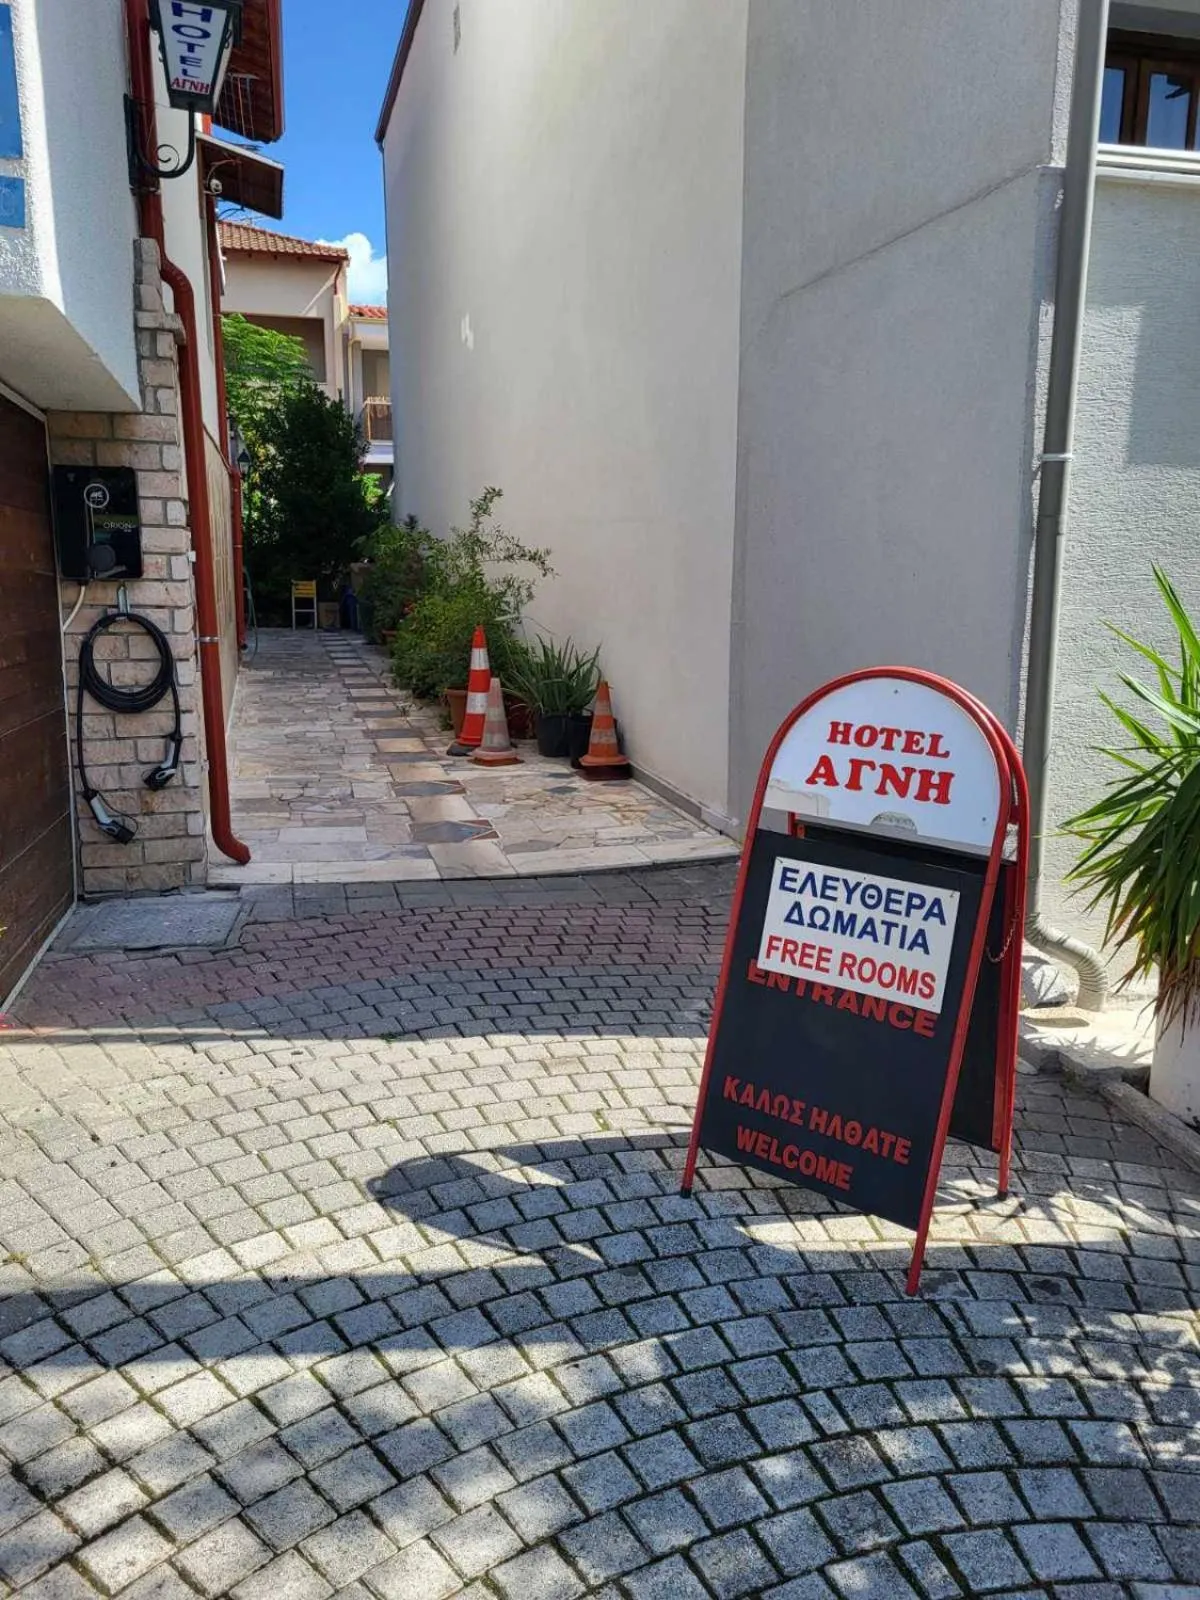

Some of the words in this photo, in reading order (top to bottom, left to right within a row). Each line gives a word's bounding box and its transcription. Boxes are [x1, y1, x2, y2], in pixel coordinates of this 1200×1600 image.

[171, 2, 213, 79] HOTEL
[827, 721, 950, 759] HOTEL
[805, 755, 955, 805] ΑΓΝΗ
[778, 866, 946, 926] ΕΛΕΥΘΕΡΑ
[783, 901, 930, 955] ΔΩΜΑΤΙΑ
[765, 935, 833, 974] FREE
[838, 951, 936, 1000] ROOMS
[723, 1075, 806, 1126] ΚΑΛΩΣ
[808, 1106, 912, 1165] ΗΛΘΑΤΕ
[736, 1125, 854, 1191] WELCOME
